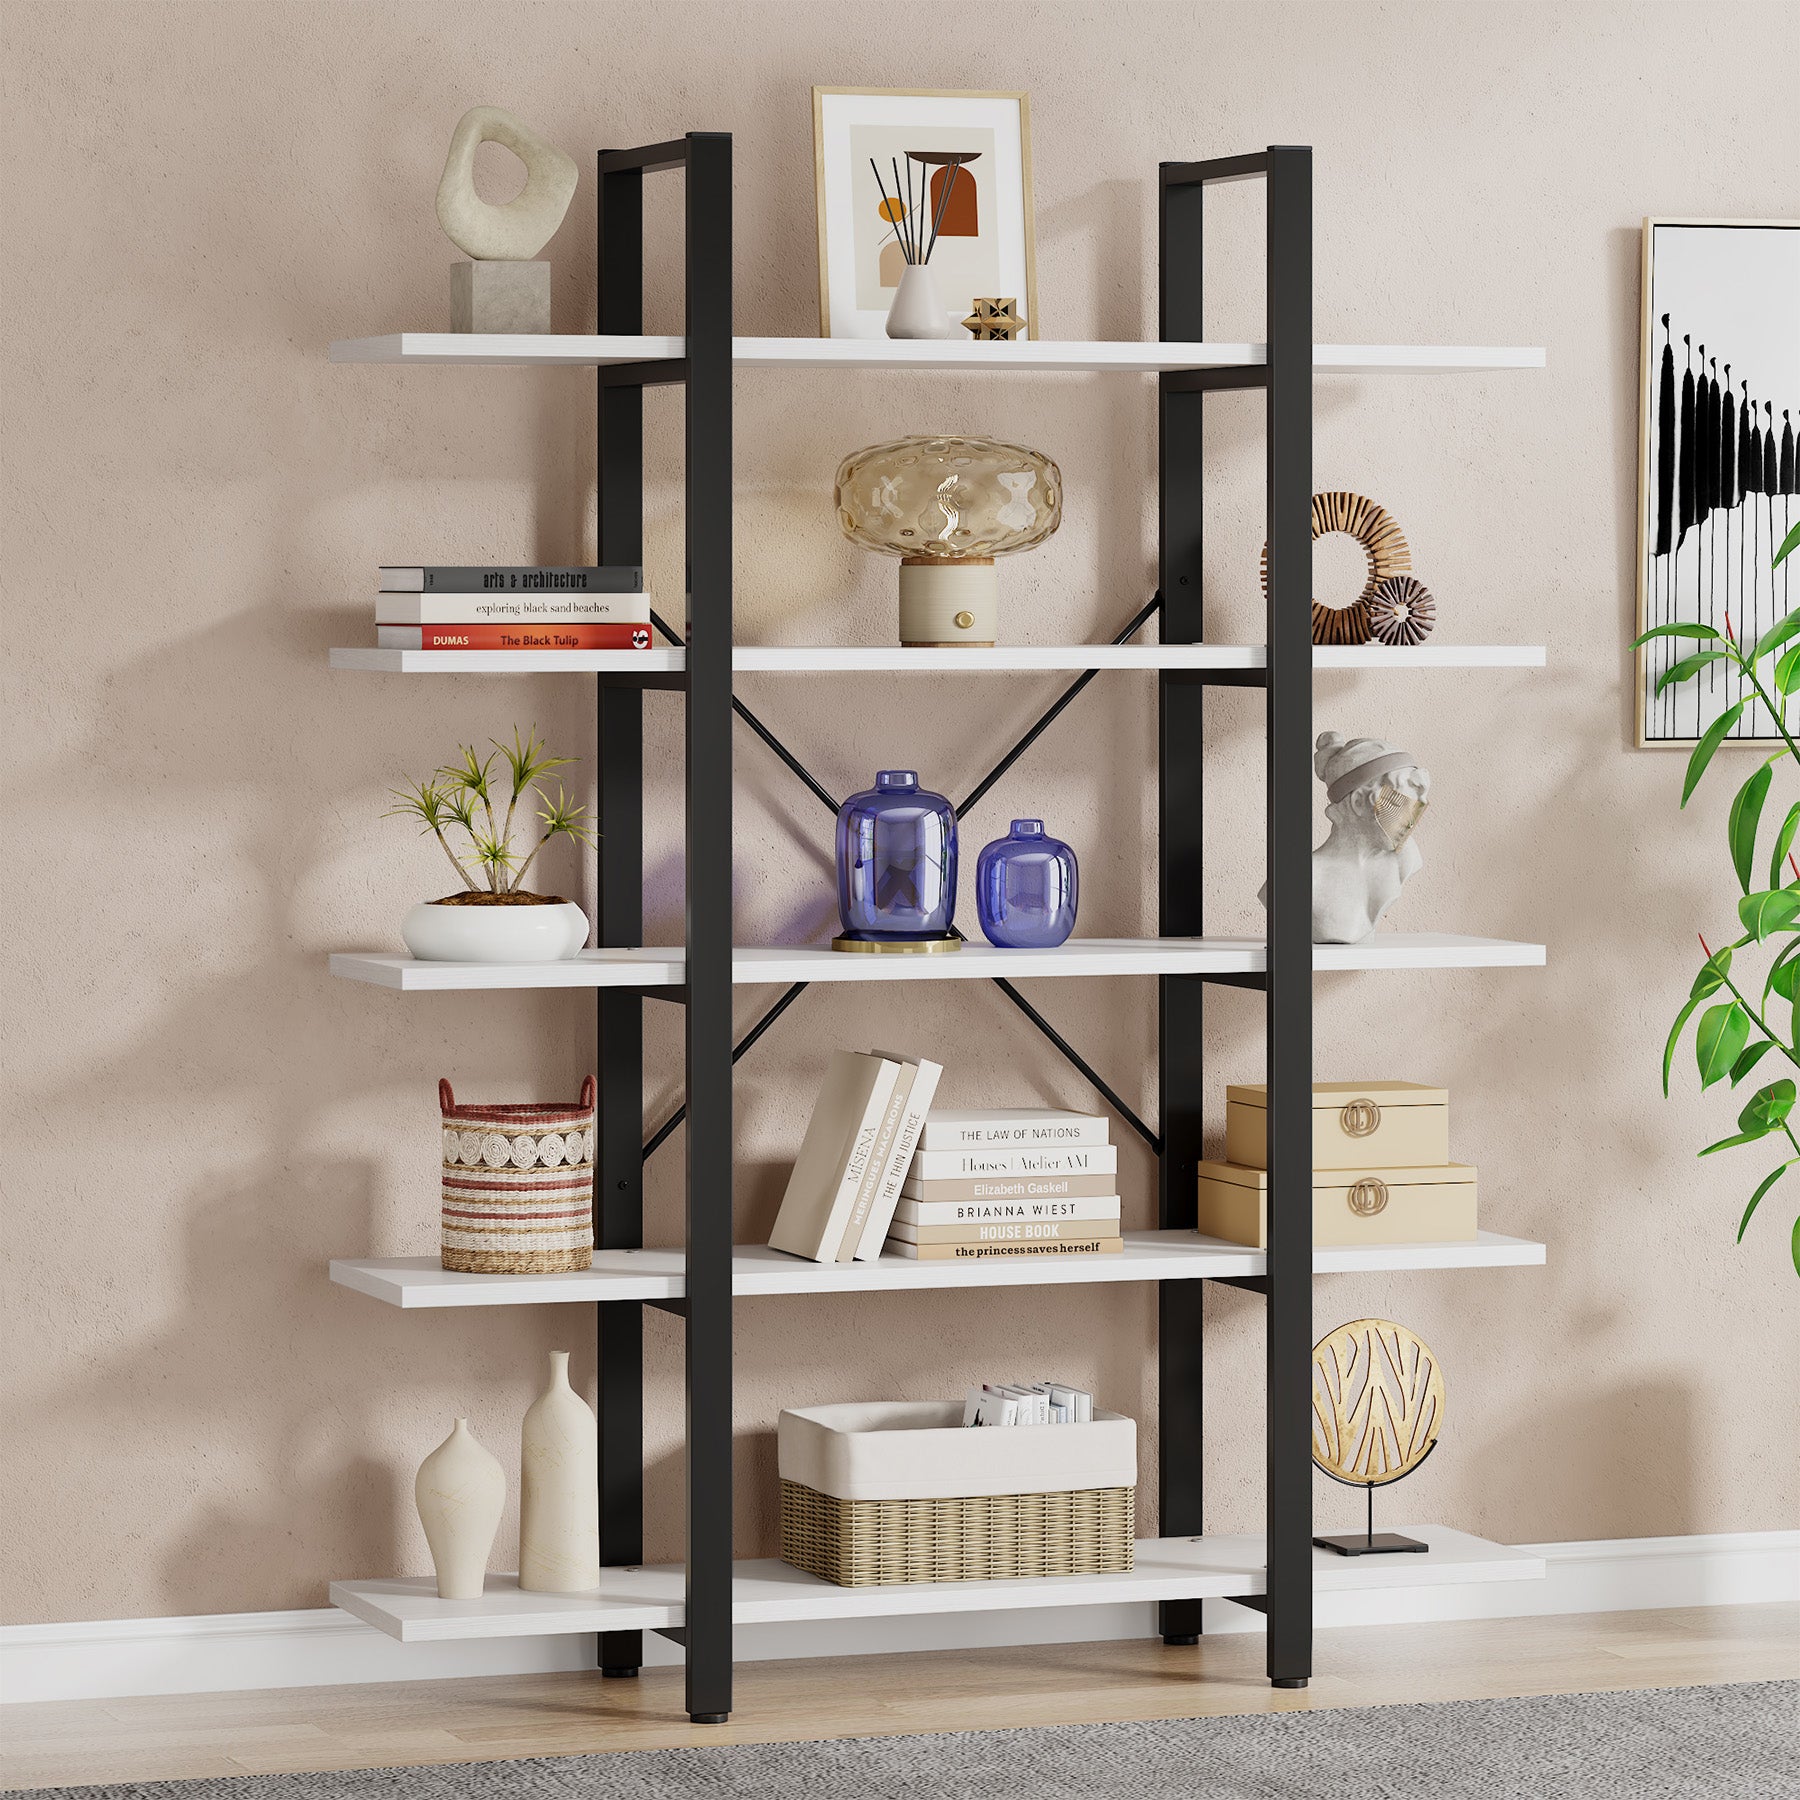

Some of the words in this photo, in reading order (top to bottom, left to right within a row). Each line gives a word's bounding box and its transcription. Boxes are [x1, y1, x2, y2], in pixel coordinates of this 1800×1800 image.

[483, 571, 505, 588] arts
[510, 574, 518, 588] &
[522, 571, 588, 588] architecture
[476, 602, 521, 616] exploring
[523, 602, 548, 613] black
[550, 602, 572, 613] sand
[573, 602, 610, 613] beaches
[433, 636, 469, 646] DUMAS
[500, 635, 520, 646] The
[523, 635, 551, 646] Black
[554, 635, 579, 647] Tulip
[899, 1112, 921, 1154] JUSTICE
[960, 1130, 982, 1141] THE
[986, 1130, 1010, 1140] LAW
[1013, 1129, 1028, 1139] OF
[1032, 1127, 1081, 1139] NATIONS
[854, 1159, 881, 1225] MERINGUES
[876, 1093, 904, 1158] MACARONS
[890, 1153, 906, 1179] THIN
[962, 1157, 1007, 1172] Houses
[1021, 1155, 1061, 1170] Atelier
[883, 1179, 898, 1199] THE
[974, 1183, 1025, 1196] Elizabeth
[1027, 1181, 1069, 1194] Gaskell
[957, 1206, 1026, 1219] BRIANNA
[1032, 1203, 1077, 1216] WIEST
[980, 1226, 1022, 1240] HOUSE
[1025, 1224, 1060, 1239] BOOK
[955, 1247, 975, 1257] the
[976, 1246, 1026, 1259] princess
[1026, 1245, 1059, 1254] saves
[1059, 1242, 1101, 1253] herself
